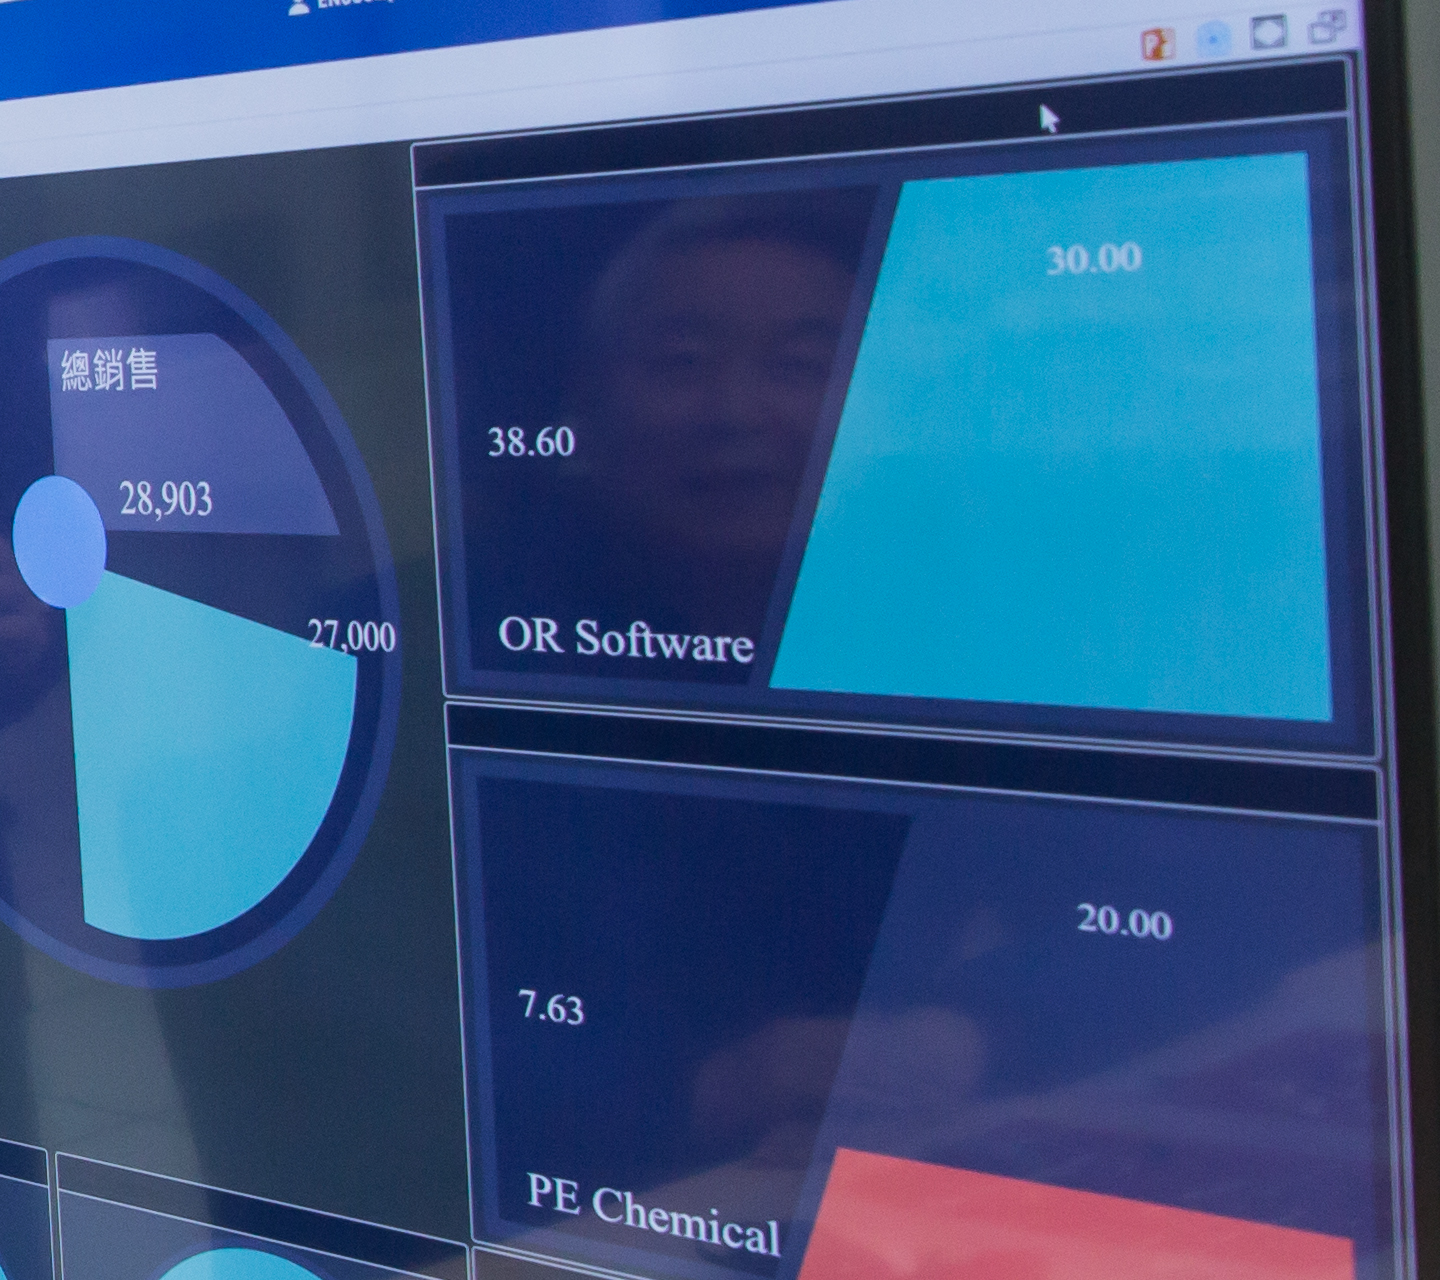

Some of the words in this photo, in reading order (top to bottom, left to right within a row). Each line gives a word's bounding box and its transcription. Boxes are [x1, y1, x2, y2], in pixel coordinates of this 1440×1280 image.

[1046, 241, 1143, 276] 30.00
[60, 347, 158, 392] 總銷售
[487, 425, 575, 459] 38.60
[119, 480, 213, 521] 28,903
[307, 618, 396, 654] 27,000
[499, 616, 566, 655] OR
[575, 618, 756, 665] Software
[1076, 901, 1173, 941] 20.00
[518, 988, 586, 1026] 7.63
[526, 1173, 582, 1216] PE
[592, 1185, 782, 1260] Chemical
